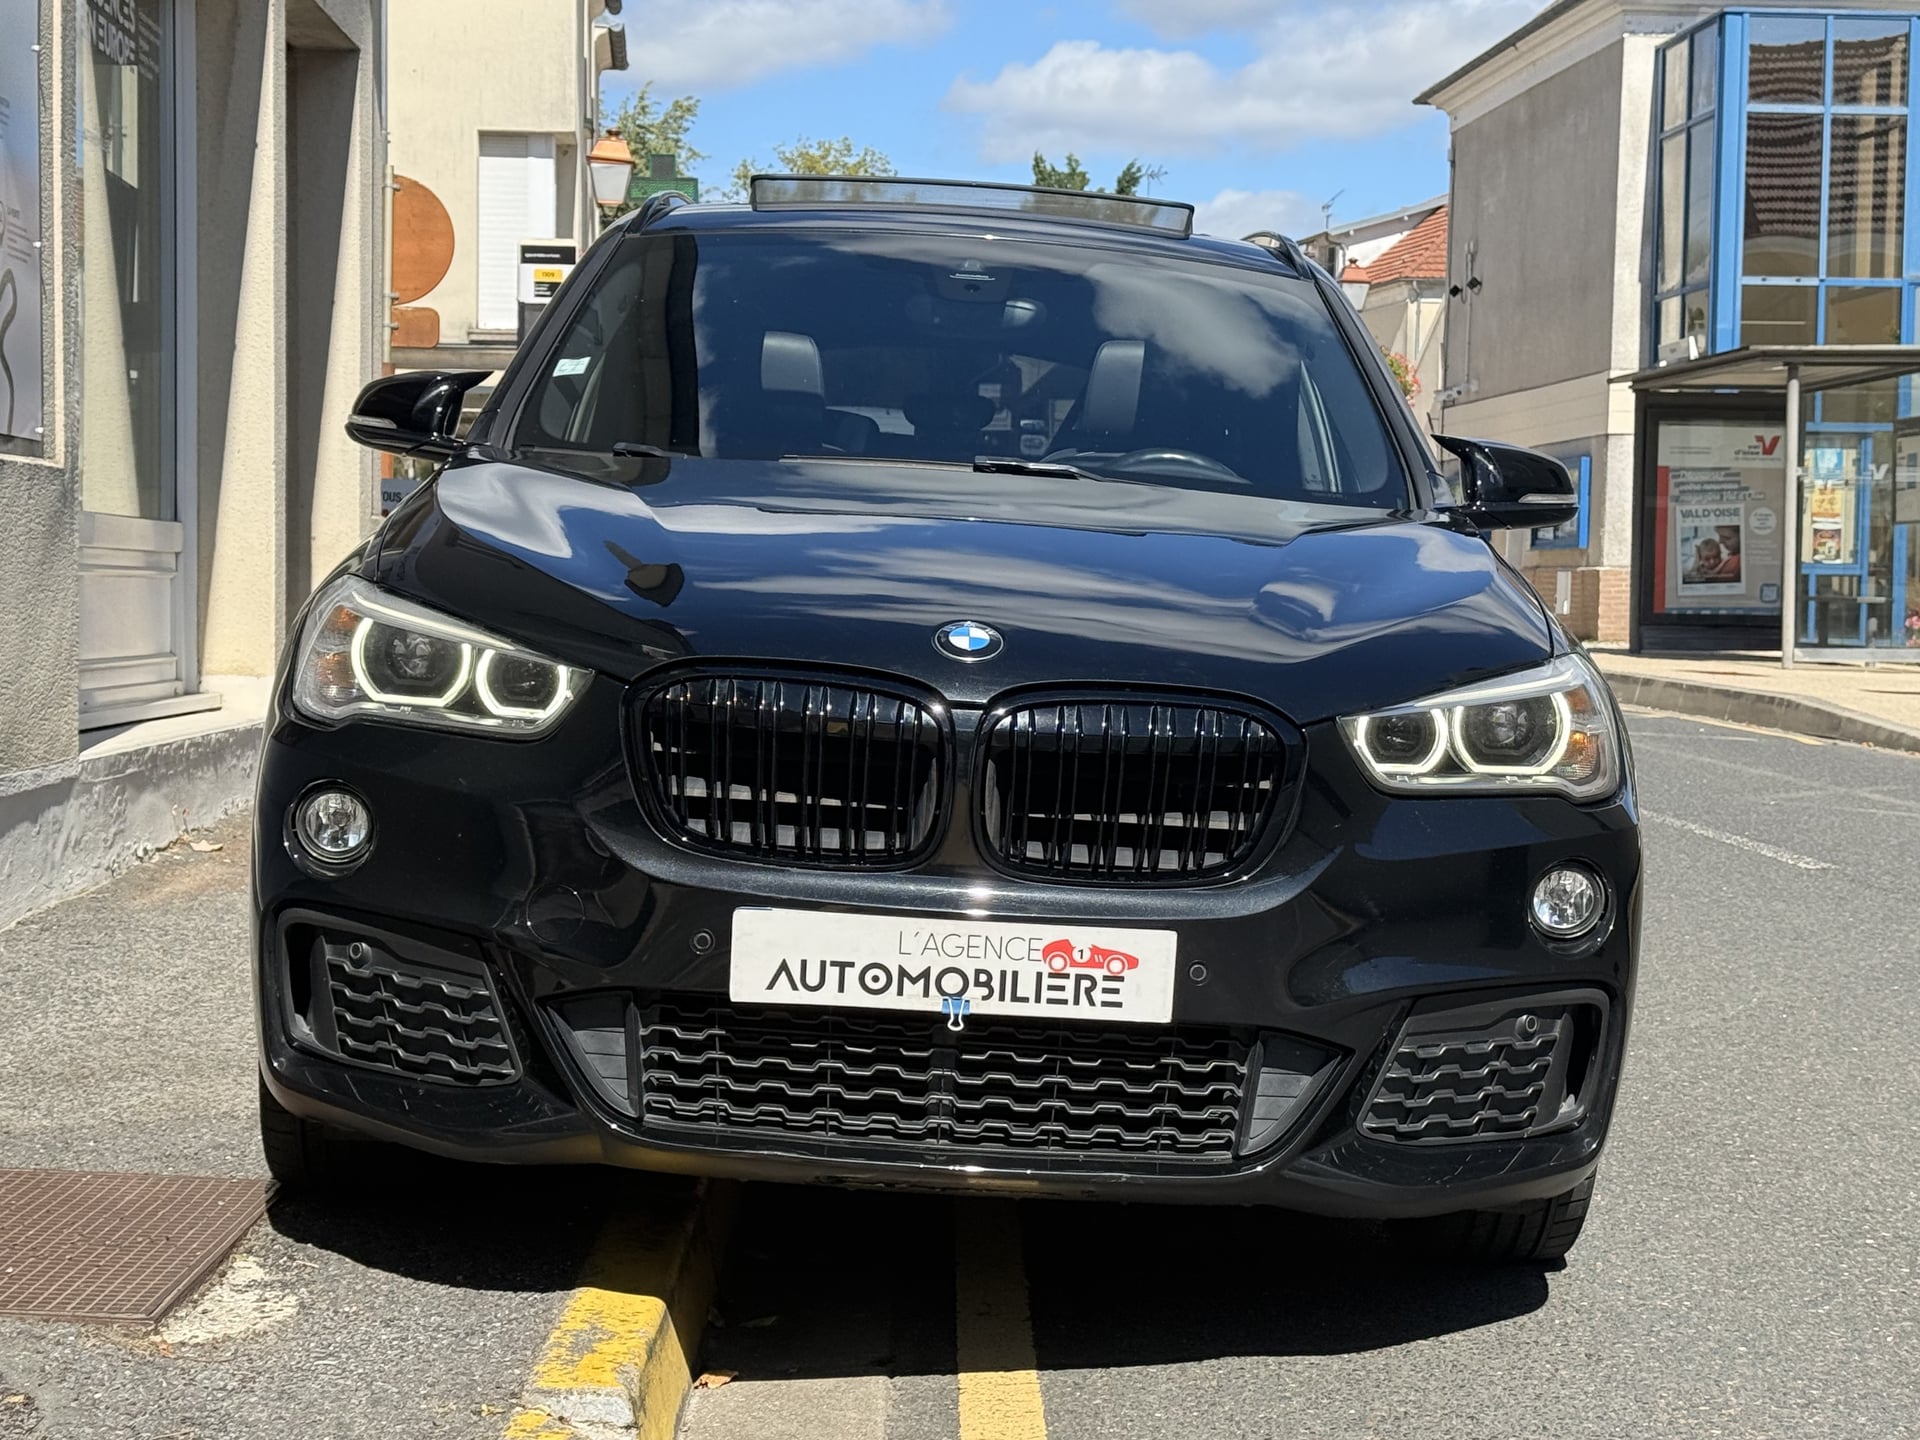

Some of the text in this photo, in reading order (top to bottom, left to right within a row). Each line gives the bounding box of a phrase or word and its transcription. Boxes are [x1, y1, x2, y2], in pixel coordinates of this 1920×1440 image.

[898, 930, 1043, 962] L'AGENCE
[1077, 948, 1085, 960] 1
[765, 957, 1125, 1008] AUTOMOBILIERE
